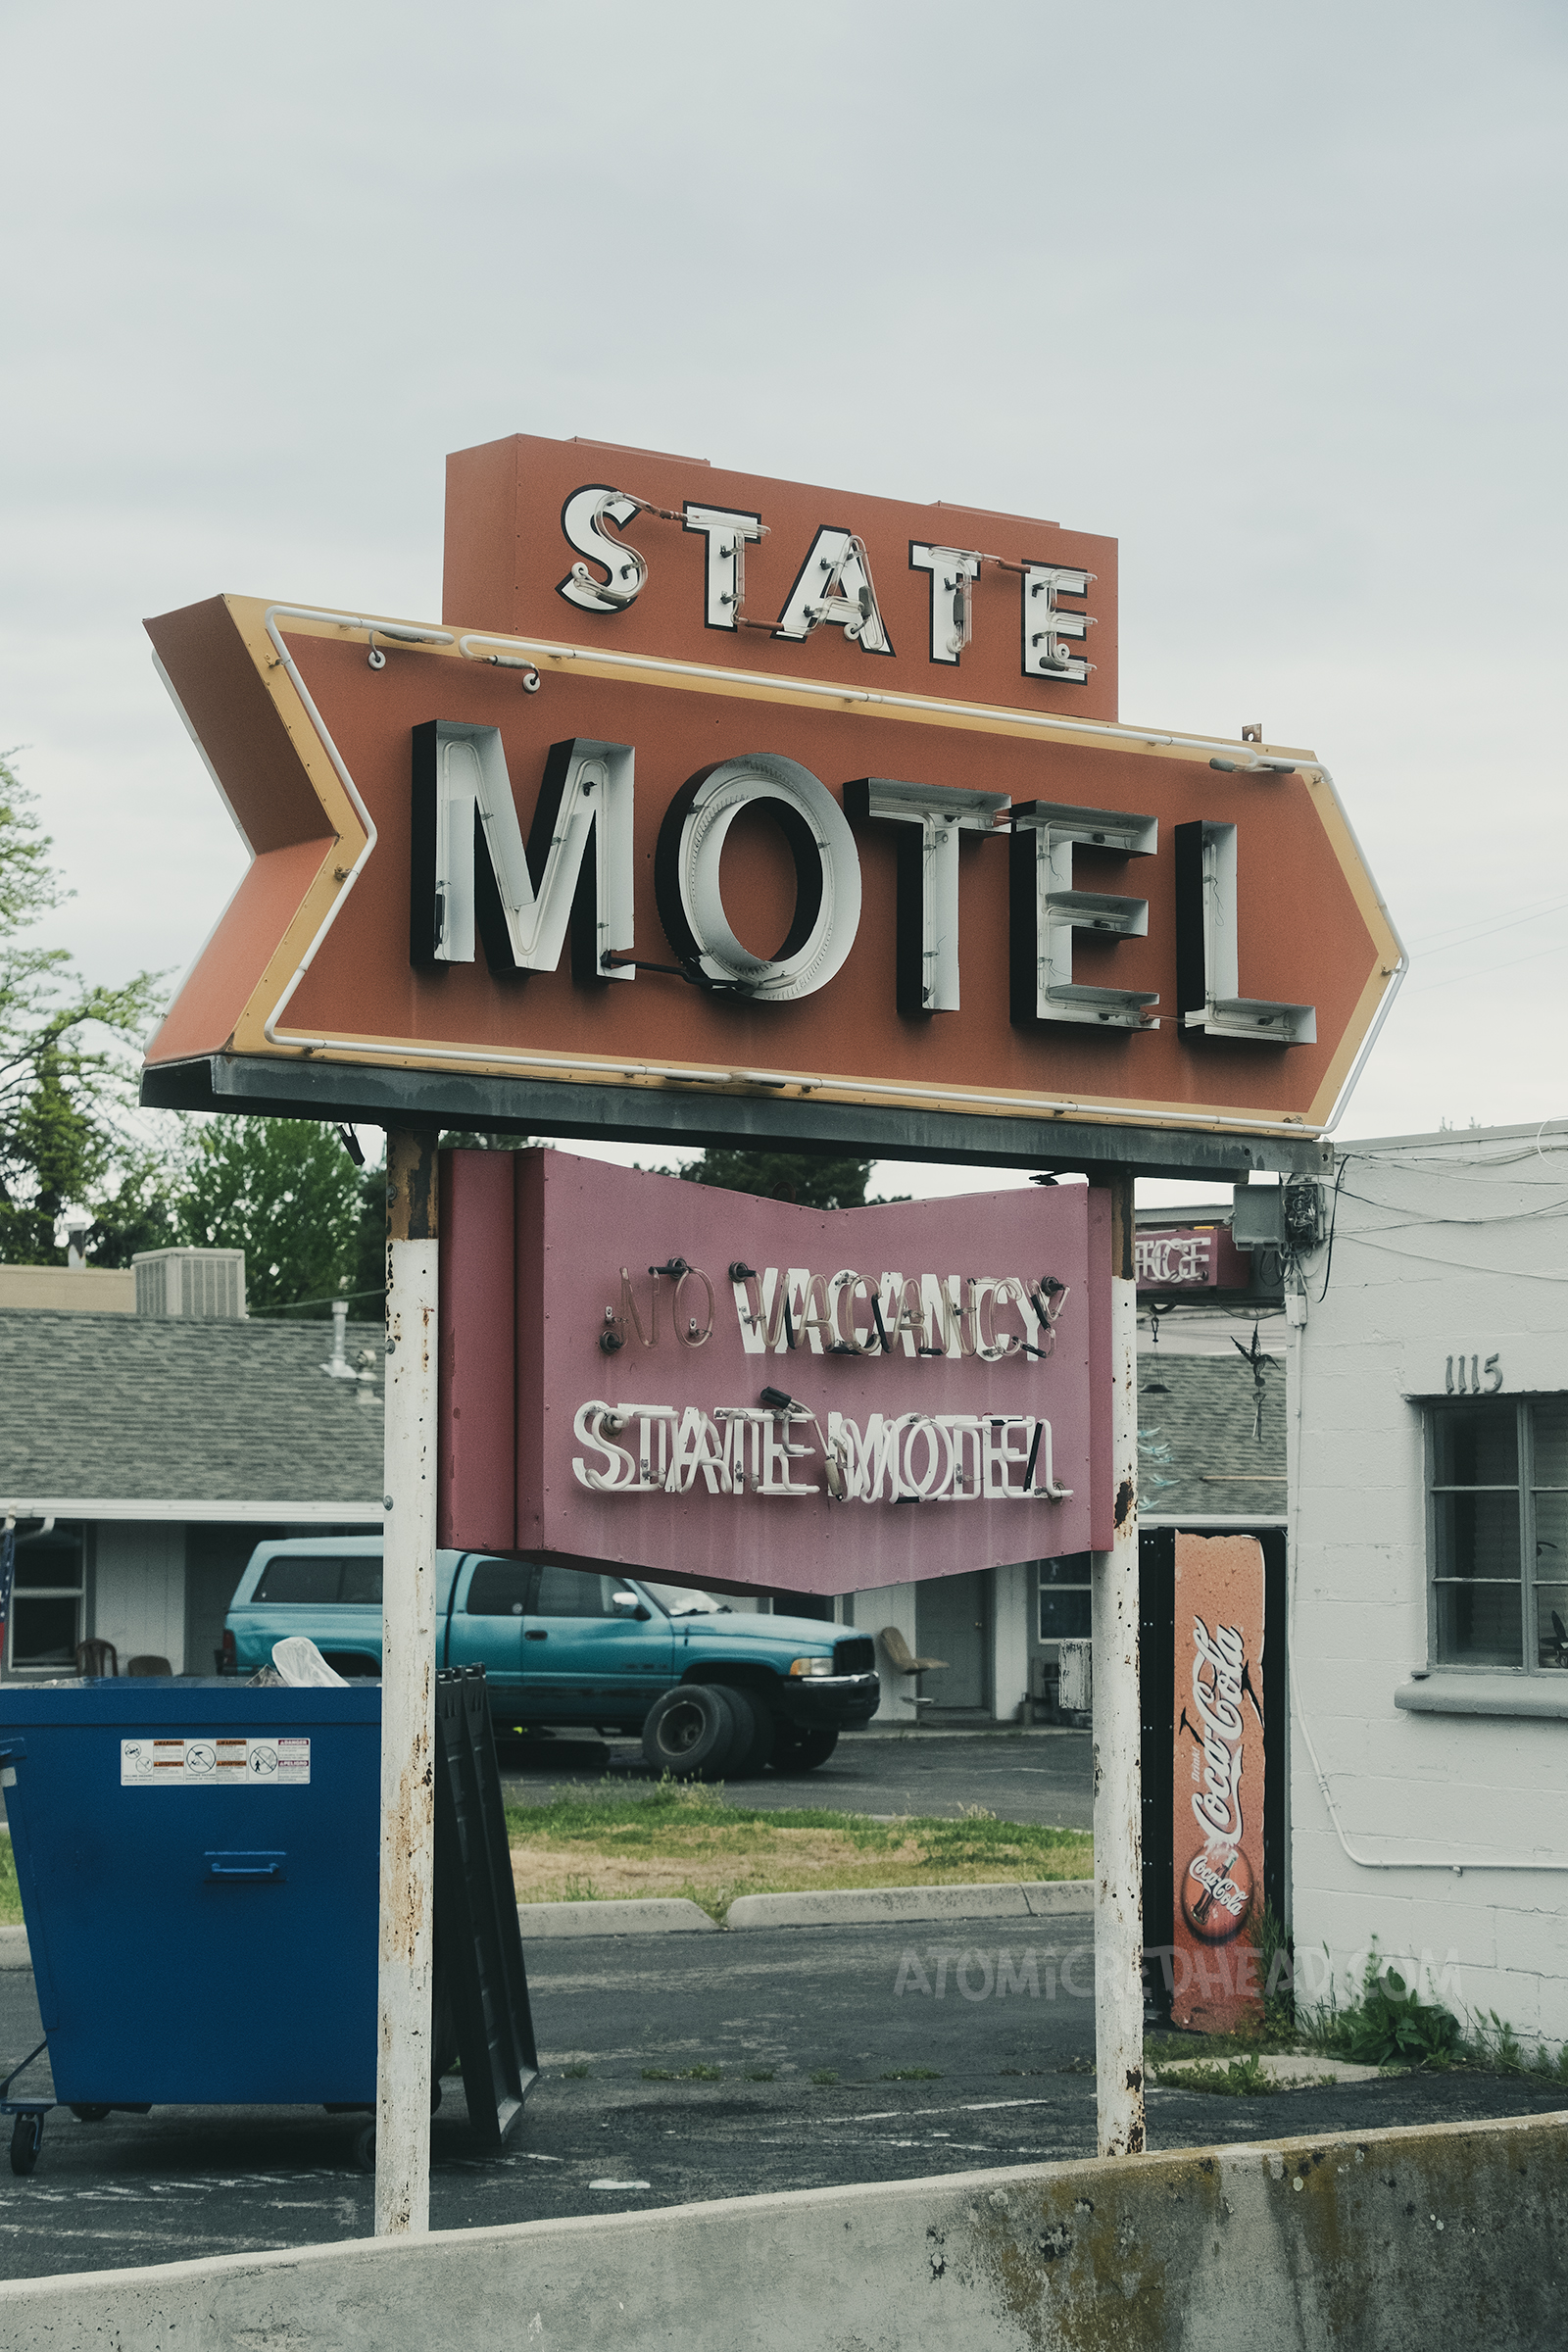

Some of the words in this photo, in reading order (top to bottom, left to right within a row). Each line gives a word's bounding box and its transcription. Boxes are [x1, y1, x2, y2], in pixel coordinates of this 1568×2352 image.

[555, 483, 1095, 685] STATE
[412, 719, 1317, 1045] MOTEL
[732, 1266, 1070, 1361] VACANCY
[1446, 1352, 1503, 1395] 1115
[571, 1399, 819, 1494] STATE
[828, 1411, 1073, 1504] MOTEL
[1192, 1614, 1245, 1847] Coca-Cola
[1189, 1855, 1249, 1916] Coca-Cola
